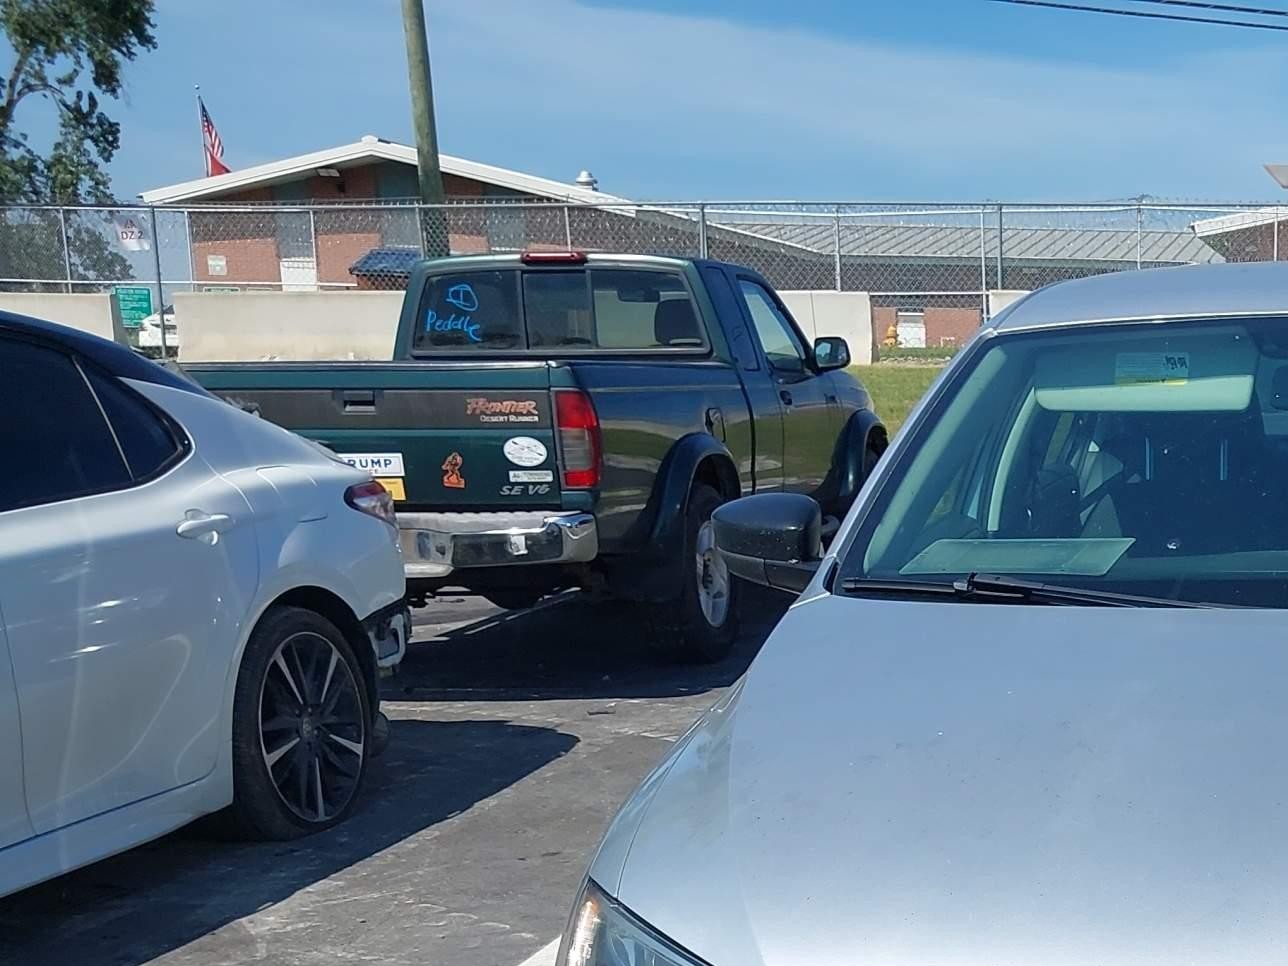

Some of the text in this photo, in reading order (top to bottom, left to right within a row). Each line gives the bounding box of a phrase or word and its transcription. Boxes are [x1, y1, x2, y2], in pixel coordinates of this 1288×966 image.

[466, 398, 539, 415] FRONTIER
[344, 458, 393, 469] RUMP
[499, 484, 551, 496] SE V6
